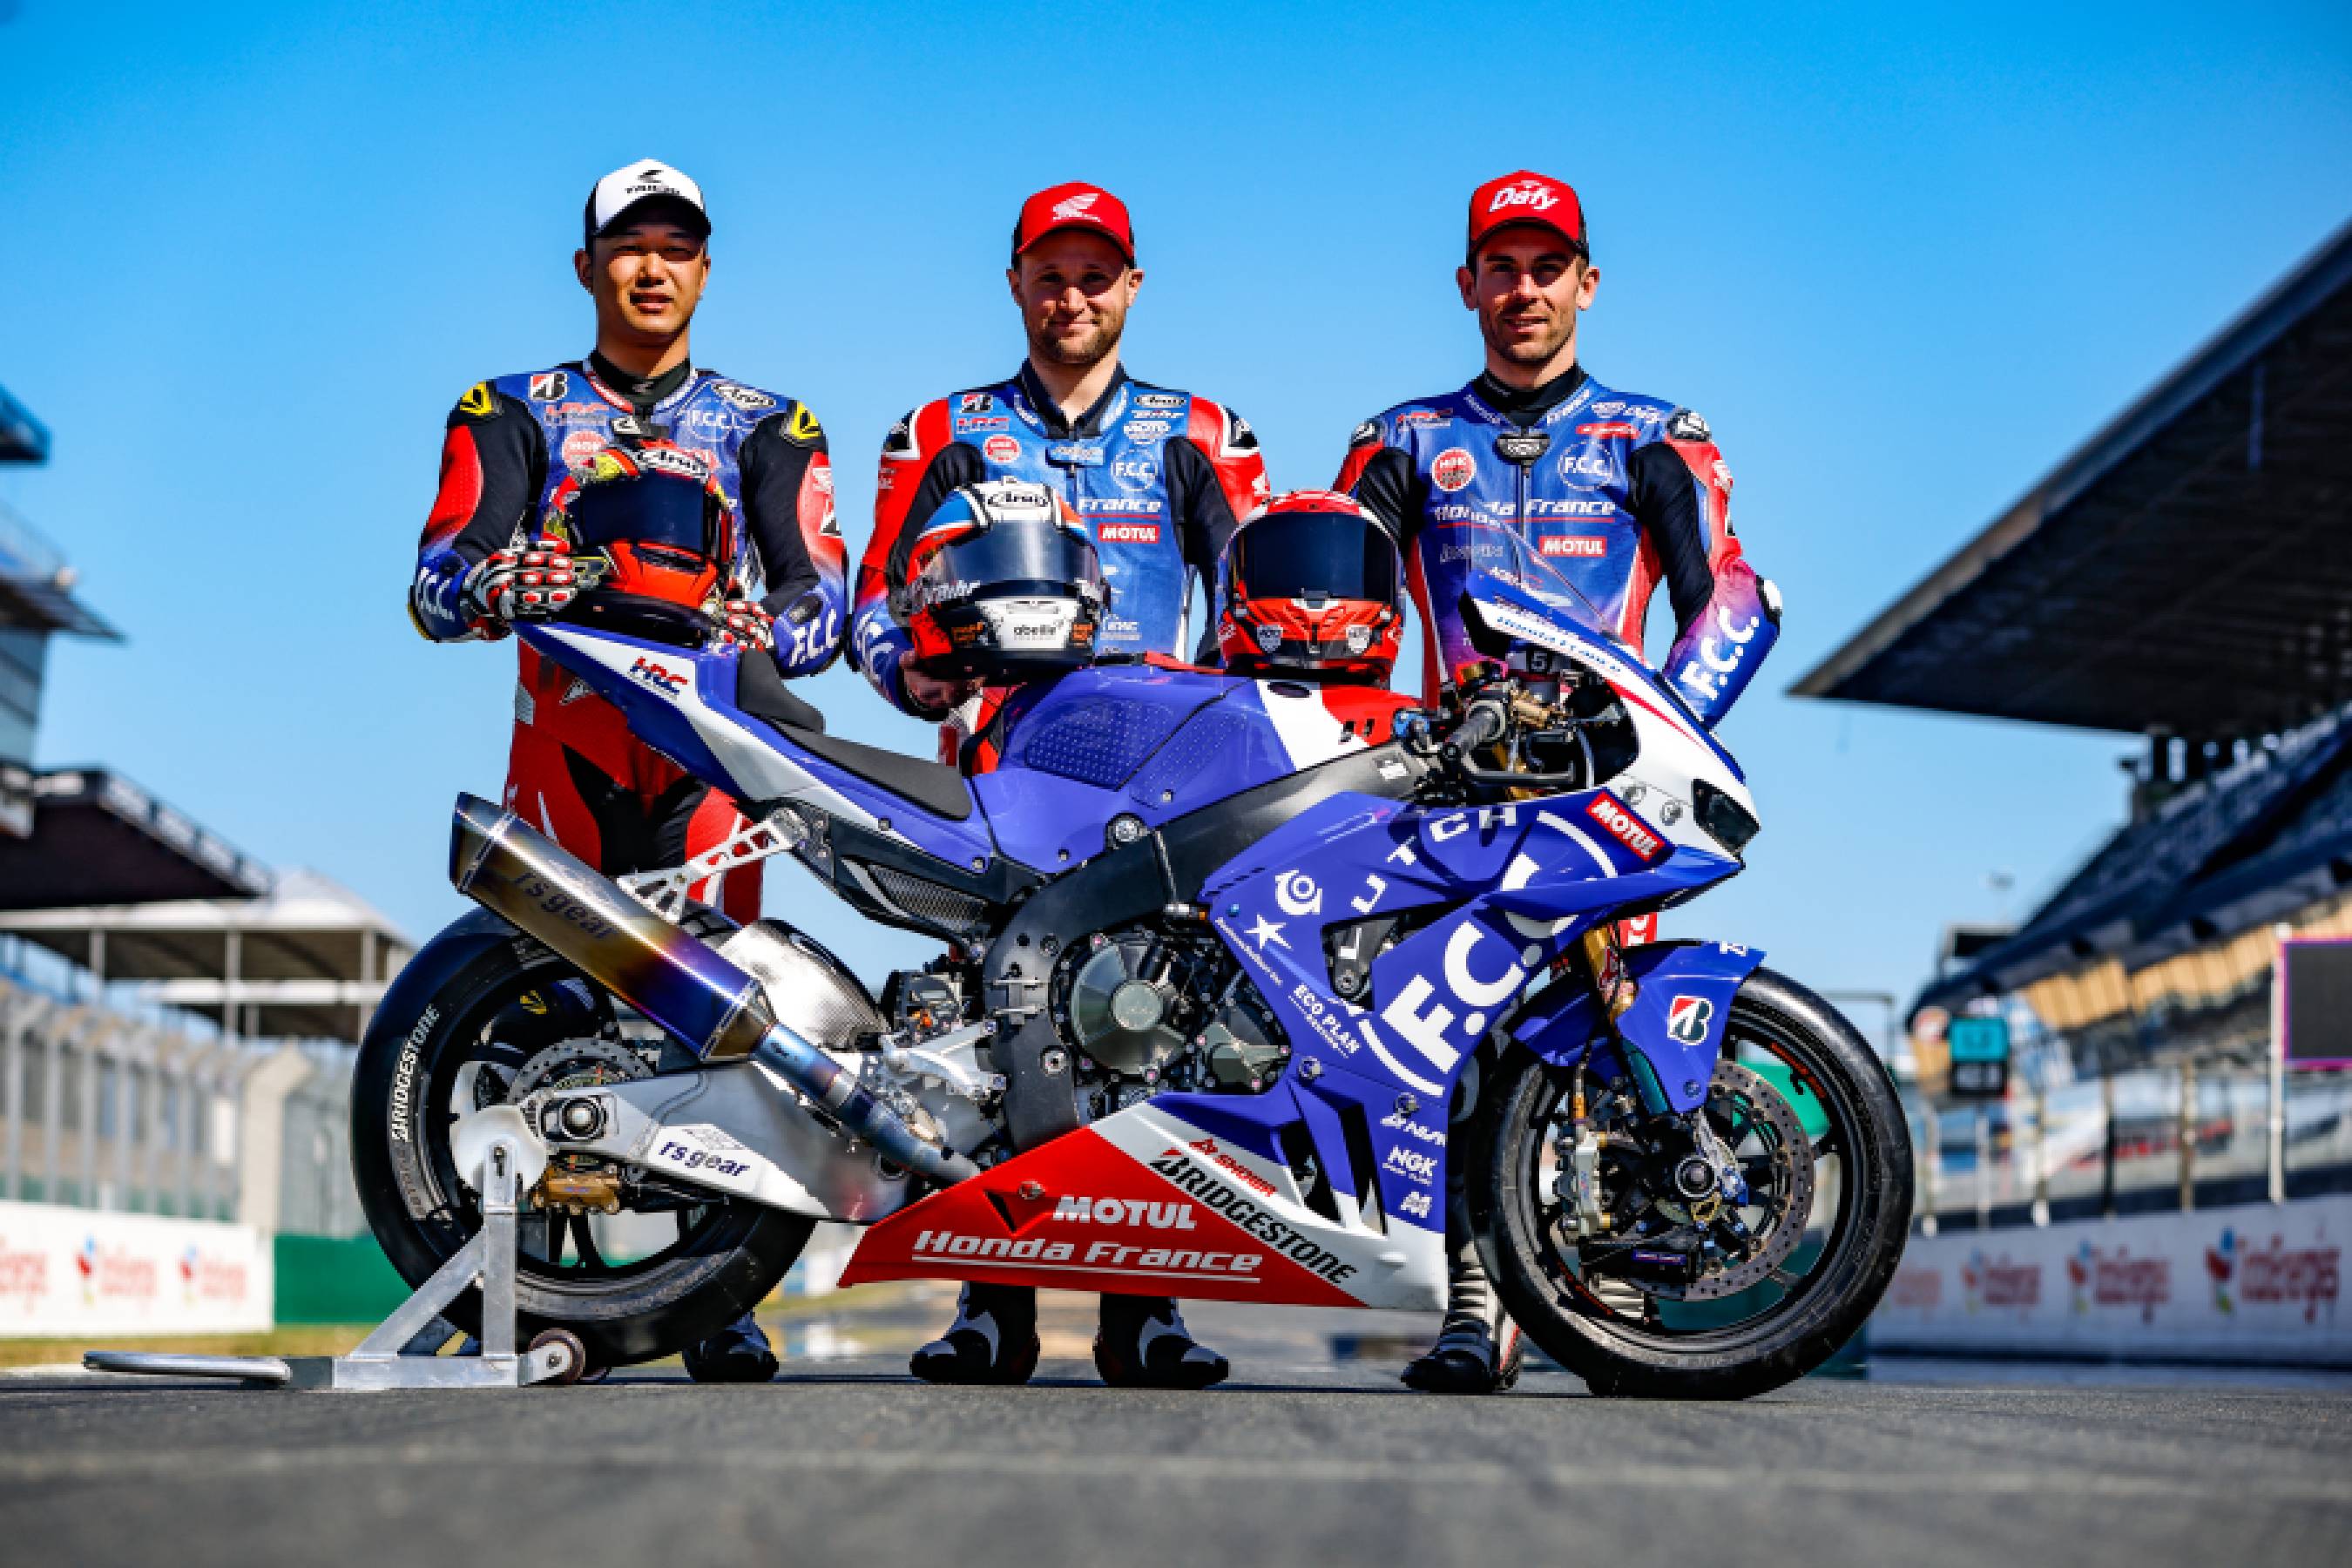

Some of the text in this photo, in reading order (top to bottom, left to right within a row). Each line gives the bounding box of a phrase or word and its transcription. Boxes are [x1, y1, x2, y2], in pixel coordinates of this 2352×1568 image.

[1489, 183, 1560, 213] Dafy
[1116, 462, 1155, 477] F.C.C.
[1565, 457, 1609, 476] F.C.C.
[1078, 499, 1161, 514] France
[1524, 498, 1616, 516] France
[1102, 526, 1157, 542] MOTUL
[1543, 538, 1604, 556] MOTUL
[1531, 652, 1548, 671] 5
[1679, 605, 1760, 701] F.C.C.
[629, 656, 688, 695] HRC
[1592, 799, 1659, 857] MOTUL
[540, 891, 618, 940] gear
[1293, 983, 1325, 1016] ECO
[1321, 1013, 1361, 1054] PLAN
[391, 1003, 440, 1142] BRIDGESTONE
[684, 1150, 751, 1177] gear
[1387, 1144, 1438, 1178] NGK
[1053, 1195, 1197, 1230] MOTUL
[1148, 1146, 1359, 1285] BRIDGESTONE
[912, 1229, 1263, 1273] Honda France
